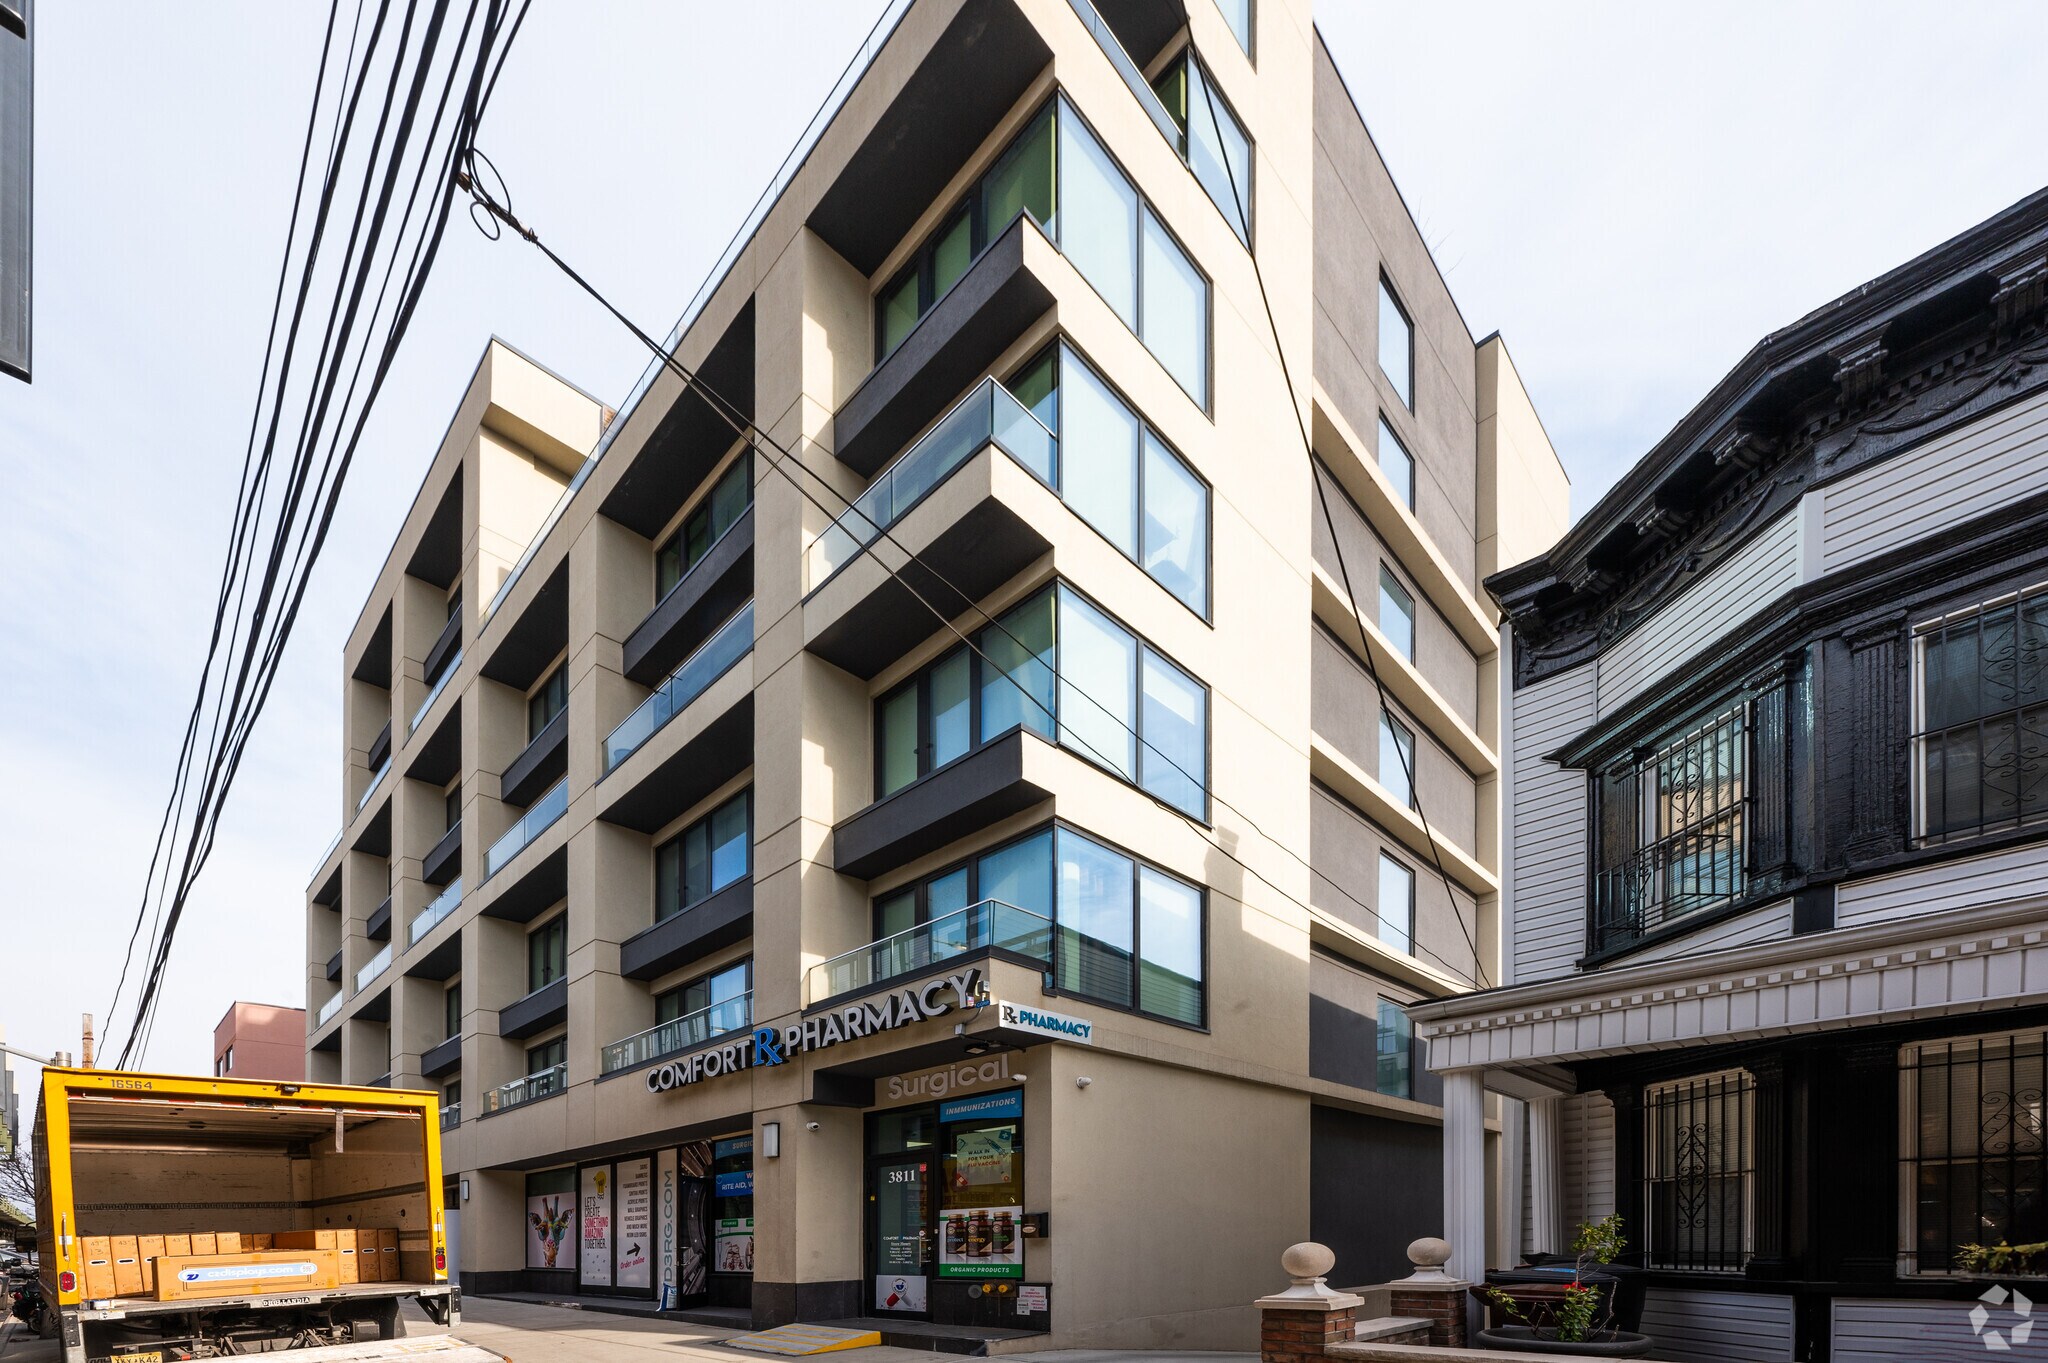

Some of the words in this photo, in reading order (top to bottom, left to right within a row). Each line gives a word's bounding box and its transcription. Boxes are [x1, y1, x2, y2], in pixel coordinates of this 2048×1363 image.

[1020, 1010, 1091, 1038] PHARMACY
[646, 1039, 752, 1093] COMFORT
[785, 968, 981, 1057] PHARMACY
[888, 1053, 1009, 1101] Surgical
[111, 1079, 153, 1090] 16564
[946, 1097, 1016, 1115] INMMUNIZATIONS
[888, 1169, 915, 1184] 3811
[735, 1182, 747, 1190] AID,
[584, 1196, 596, 1207] LET'S
[584, 1206, 600, 1217] CREATE
[584, 1216, 608, 1228] SOMETHING
[584, 1227, 604, 1238] AMAZING
[584, 1238, 607, 1249] TOGETHER.
[620, 1261, 632, 1270] Order
[632, 1257, 645, 1265] online
[263, 1297, 310, 1306] DHOLLANDIA
